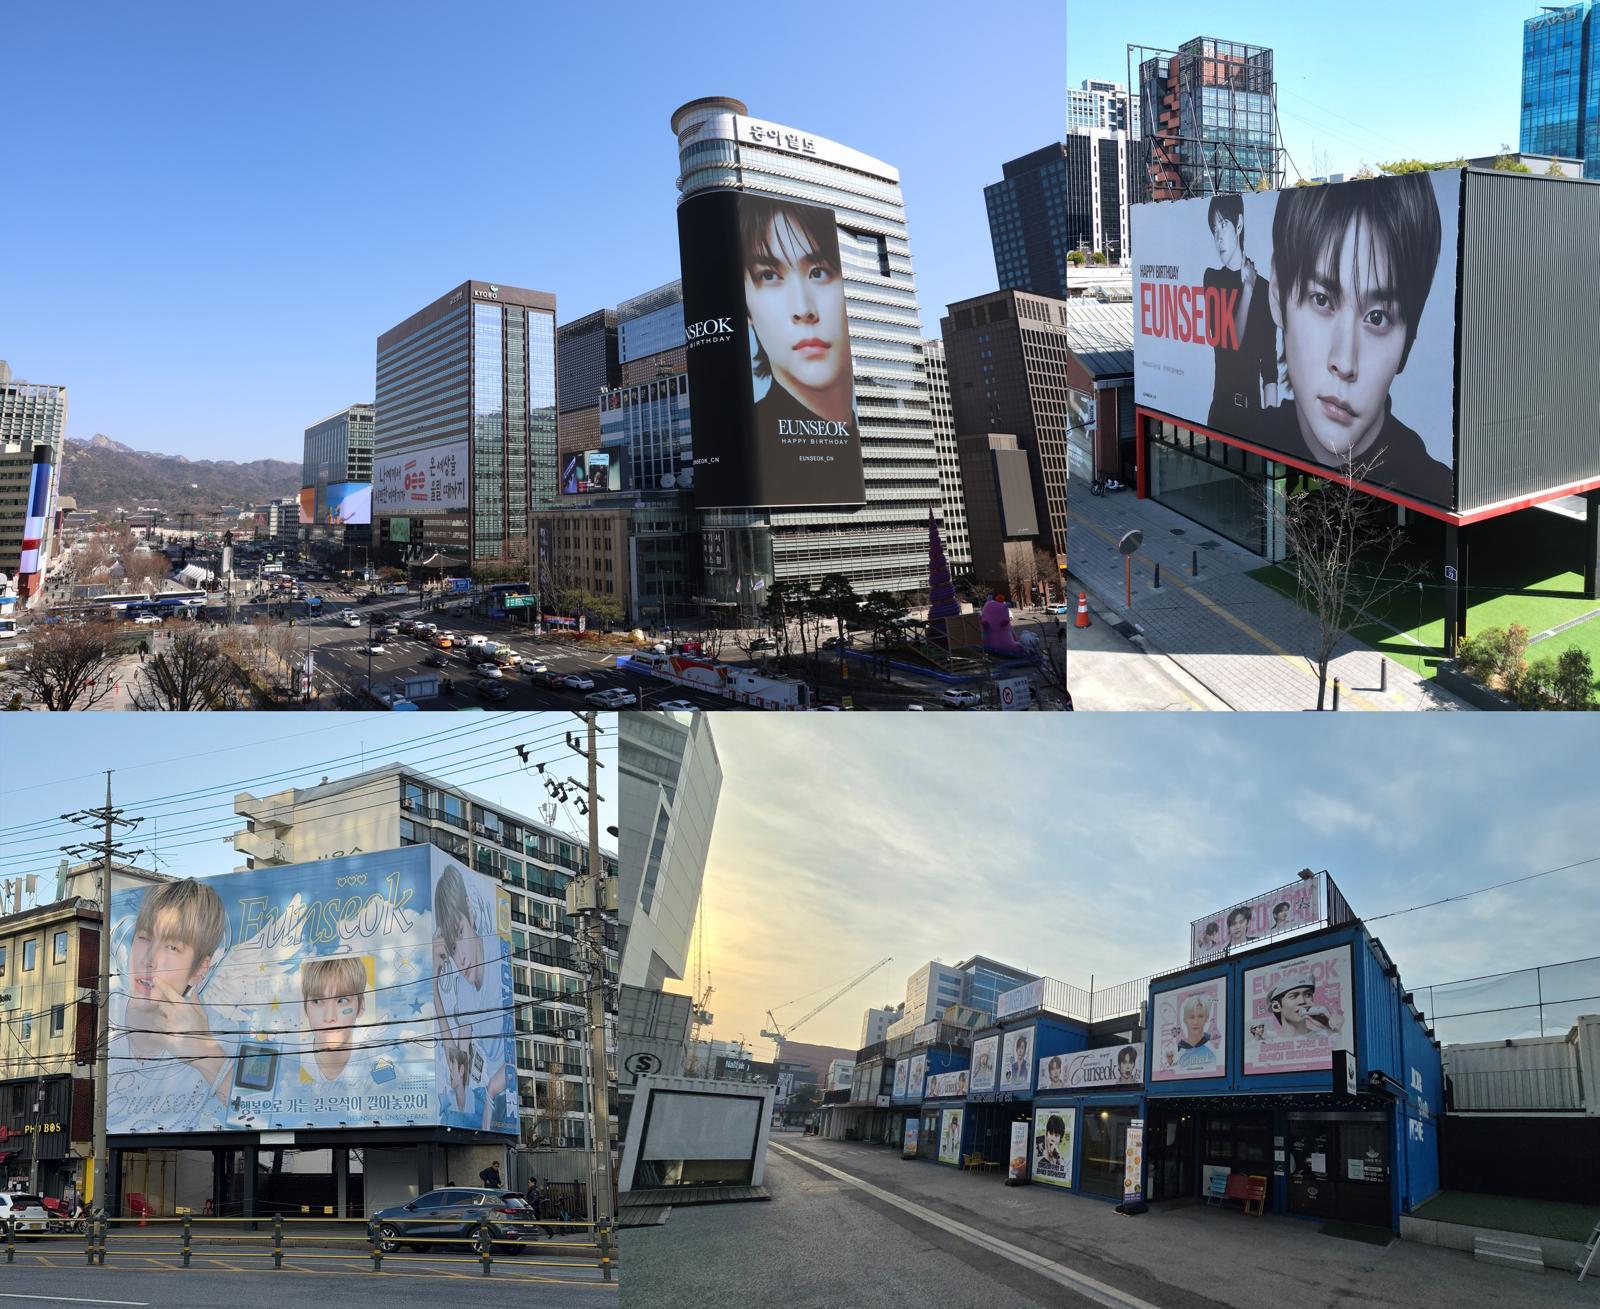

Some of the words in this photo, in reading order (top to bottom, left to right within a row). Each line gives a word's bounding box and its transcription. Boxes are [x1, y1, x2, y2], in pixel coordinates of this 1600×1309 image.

[749, 125, 816, 154] 동아일보
[1140, 264, 1155, 280] HAPPY
[1156, 265, 1179, 281] BIRTHDAY
[1140, 282, 1240, 352] EUNSEOK
[690, 335, 731, 349] BIRTHDAY
[778, 419, 850, 437] EUNSEOK
[237, 871, 415, 951] Eunseok
[1068, 1053, 1117, 1086] Eunseok
[287, 1098, 309, 1113] 가는
[368, 1093, 429, 1111] 깔아놓았어
[43, 1122, 62, 1133] BOS
